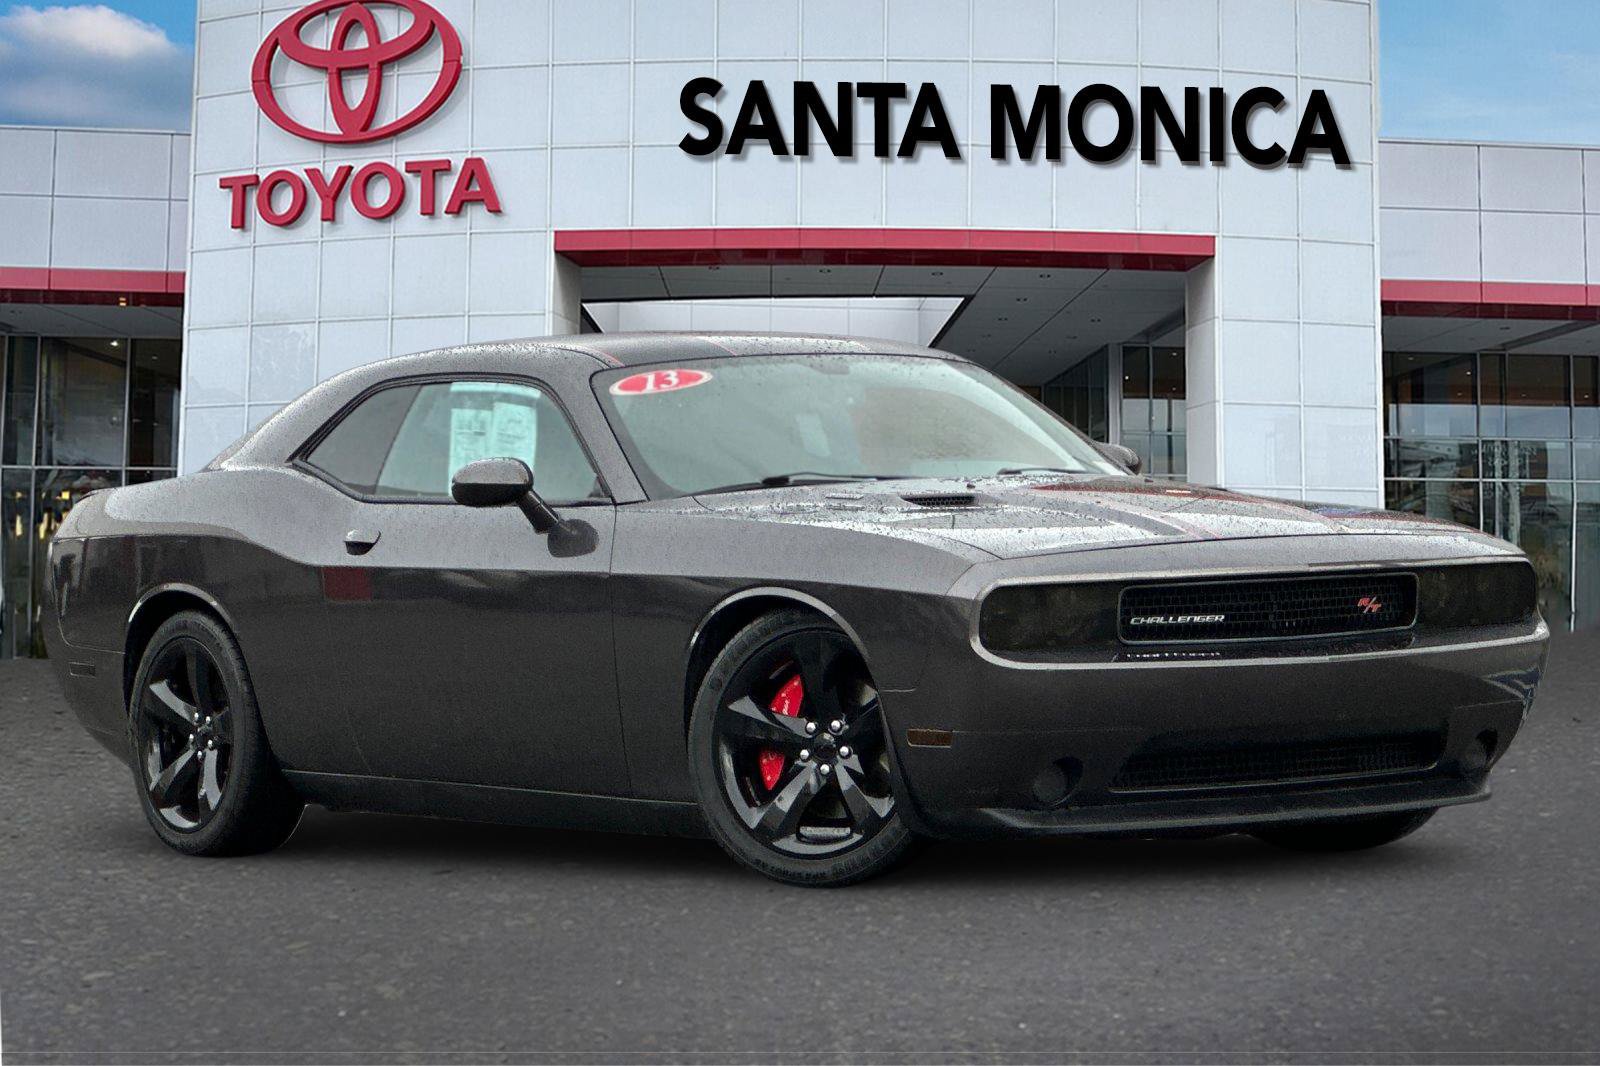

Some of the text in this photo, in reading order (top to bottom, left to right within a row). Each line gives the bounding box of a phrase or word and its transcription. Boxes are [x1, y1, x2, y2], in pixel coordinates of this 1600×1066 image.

[678, 77, 1351, 166] SANTA MONICA
[219, 157, 503, 230] TOYOTA
[644, 370, 679, 392] 13
[1130, 614, 1225, 626] CHALLENGER
